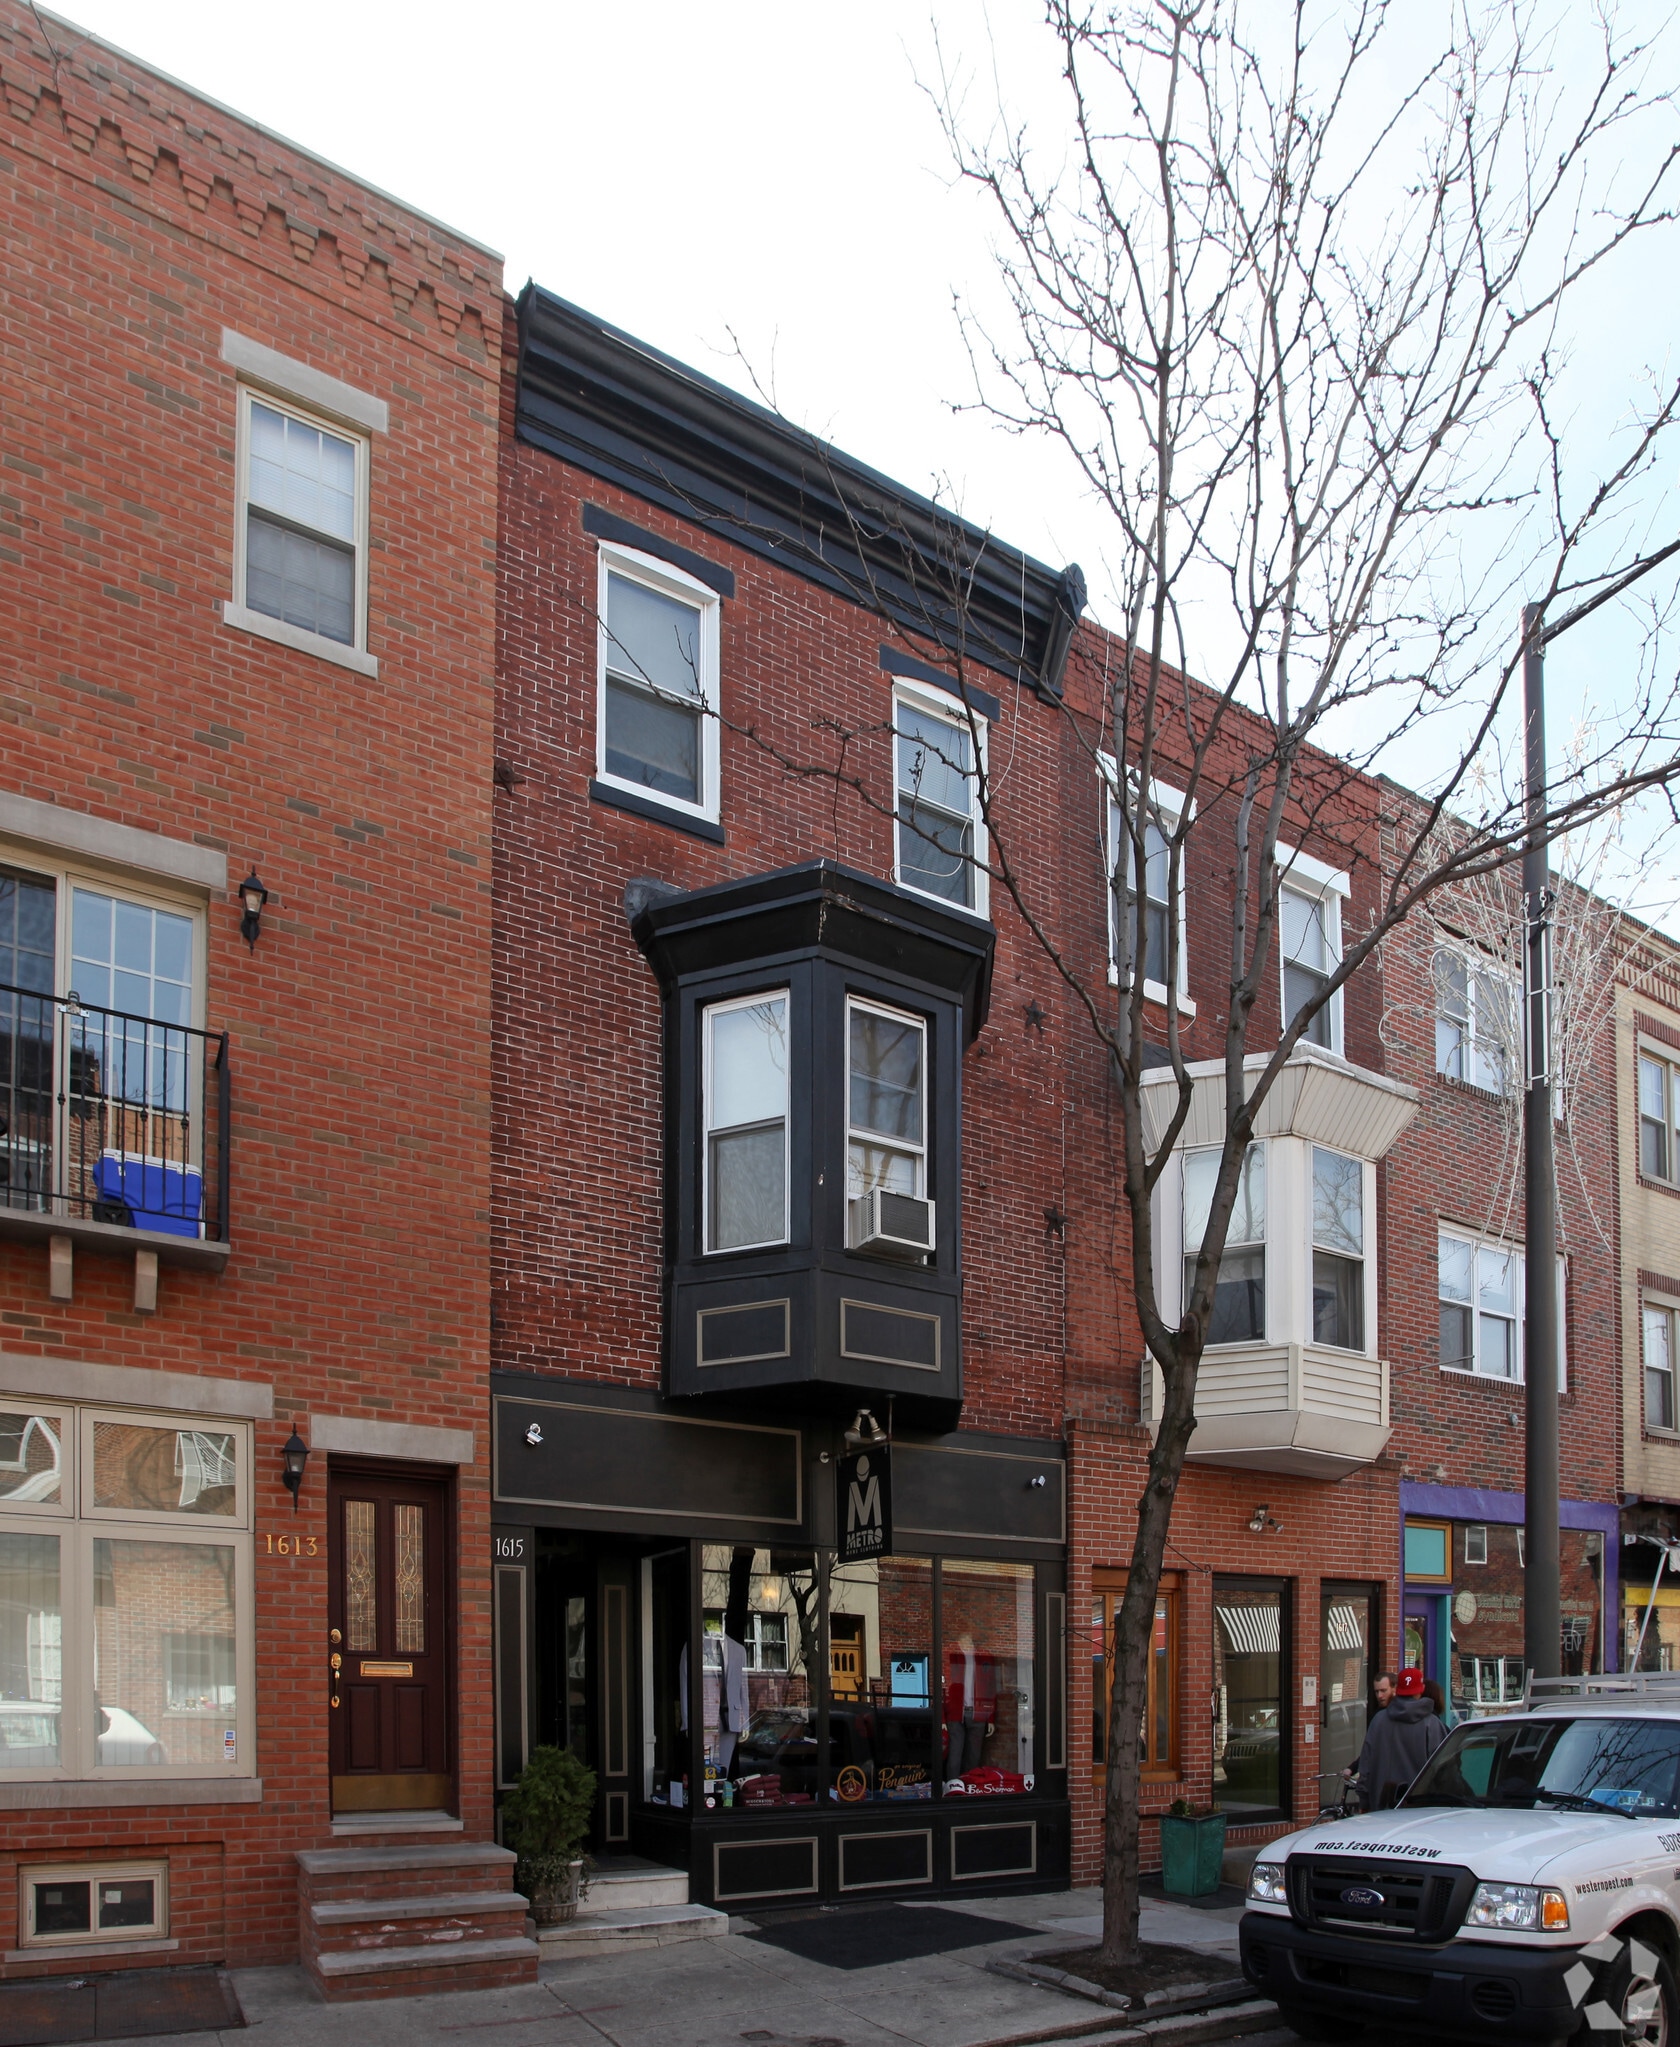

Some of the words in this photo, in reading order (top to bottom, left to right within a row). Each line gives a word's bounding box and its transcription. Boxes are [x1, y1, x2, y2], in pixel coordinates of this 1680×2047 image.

[265, 1534, 318, 1557] 1613
[495, 1537, 524, 1558] 1615
[846, 1527, 883, 1550] METRO
[1336, 1622, 1348, 1633] 1617
[1405, 1676, 1412, 1686] P
[878, 1767, 927, 1793] Penguin
[966, 1783, 983, 1795] Ben
[983, 1783, 1015, 1794] Sherman
[1575, 1877, 1634, 1895] westernpest.com
[1347, 1890, 1372, 1905] Ford
